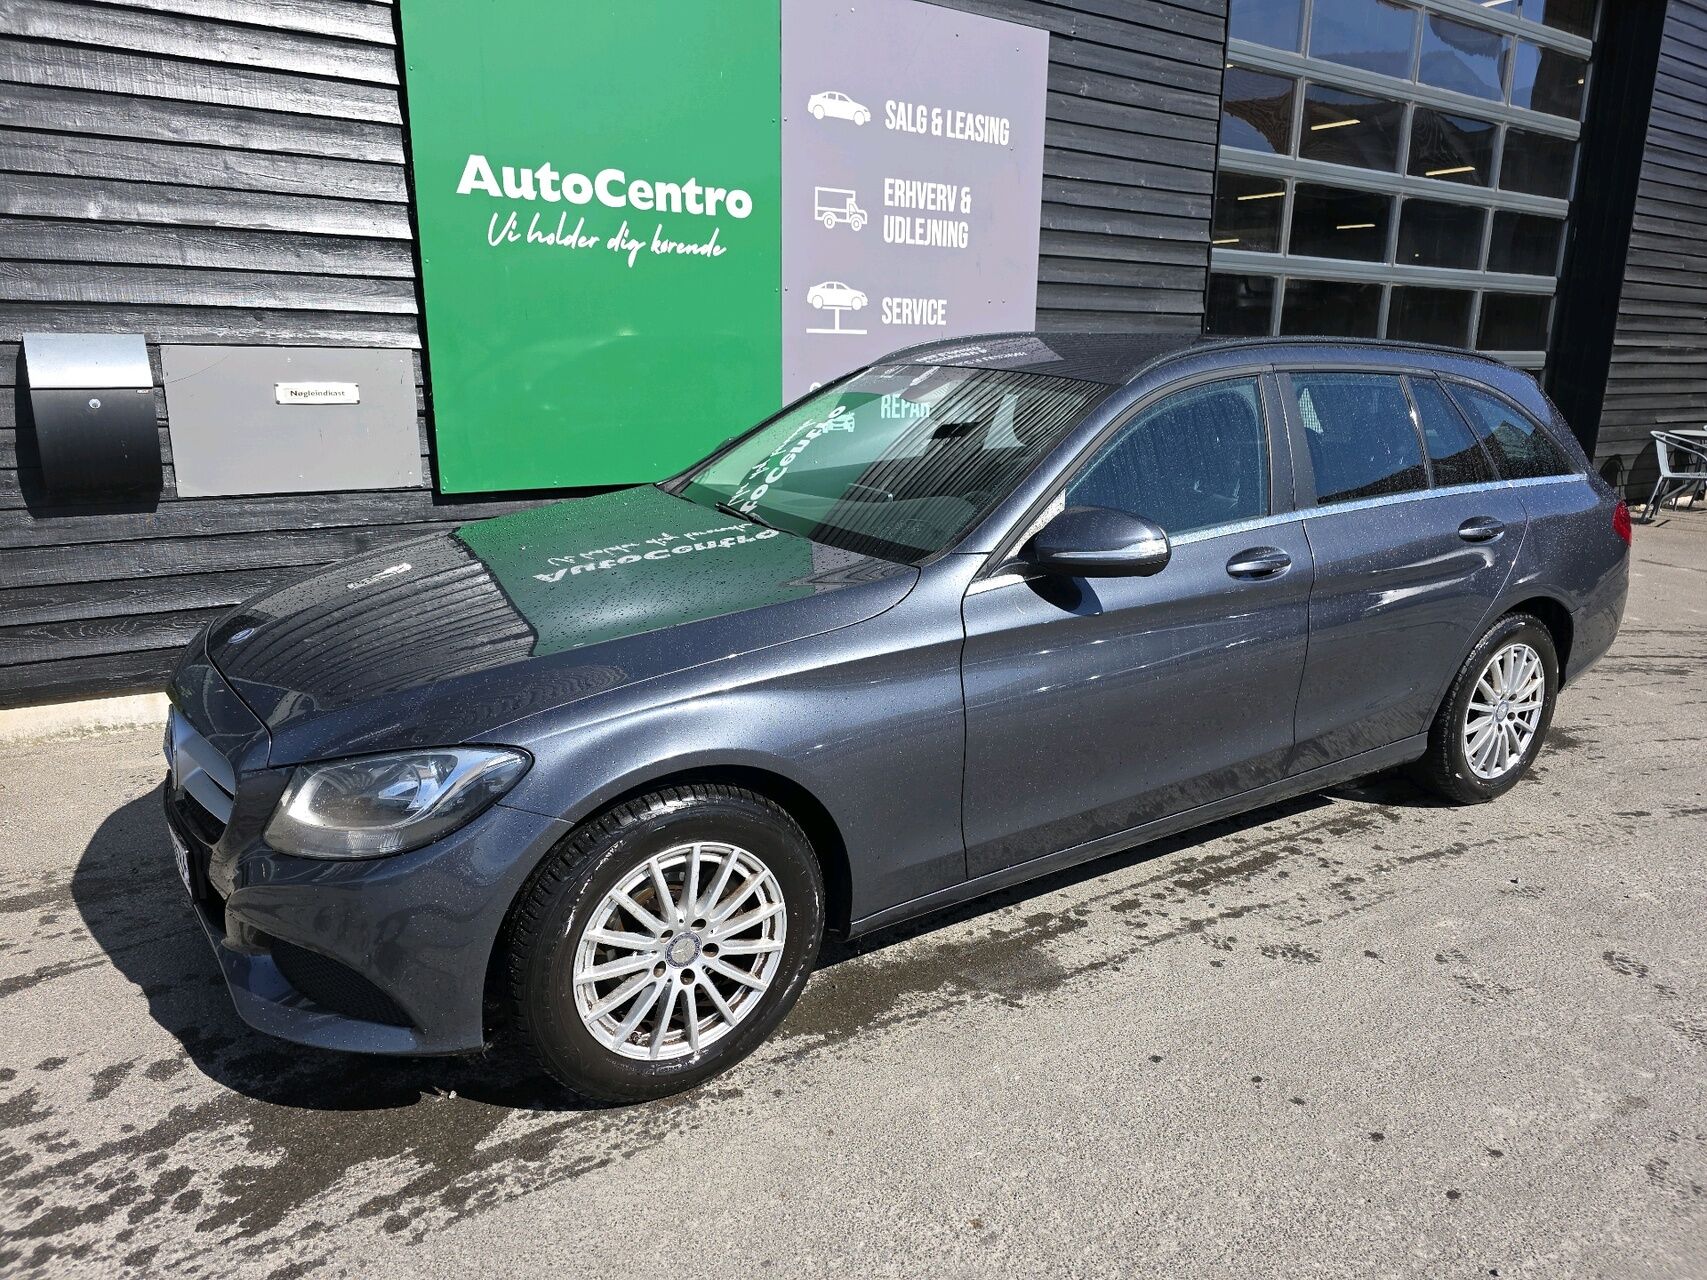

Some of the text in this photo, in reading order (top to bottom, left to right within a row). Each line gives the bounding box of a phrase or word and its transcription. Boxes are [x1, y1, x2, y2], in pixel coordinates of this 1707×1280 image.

[885, 100, 1010, 146] SALG & LEASING
[456, 154, 753, 219] AutoCentro
[884, 178, 972, 214] ERHVERV &
[487, 211, 727, 268] Vi holder dig kørende
[883, 214, 969, 249] UDLEJNING
[881, 296, 948, 326] SERVICE
